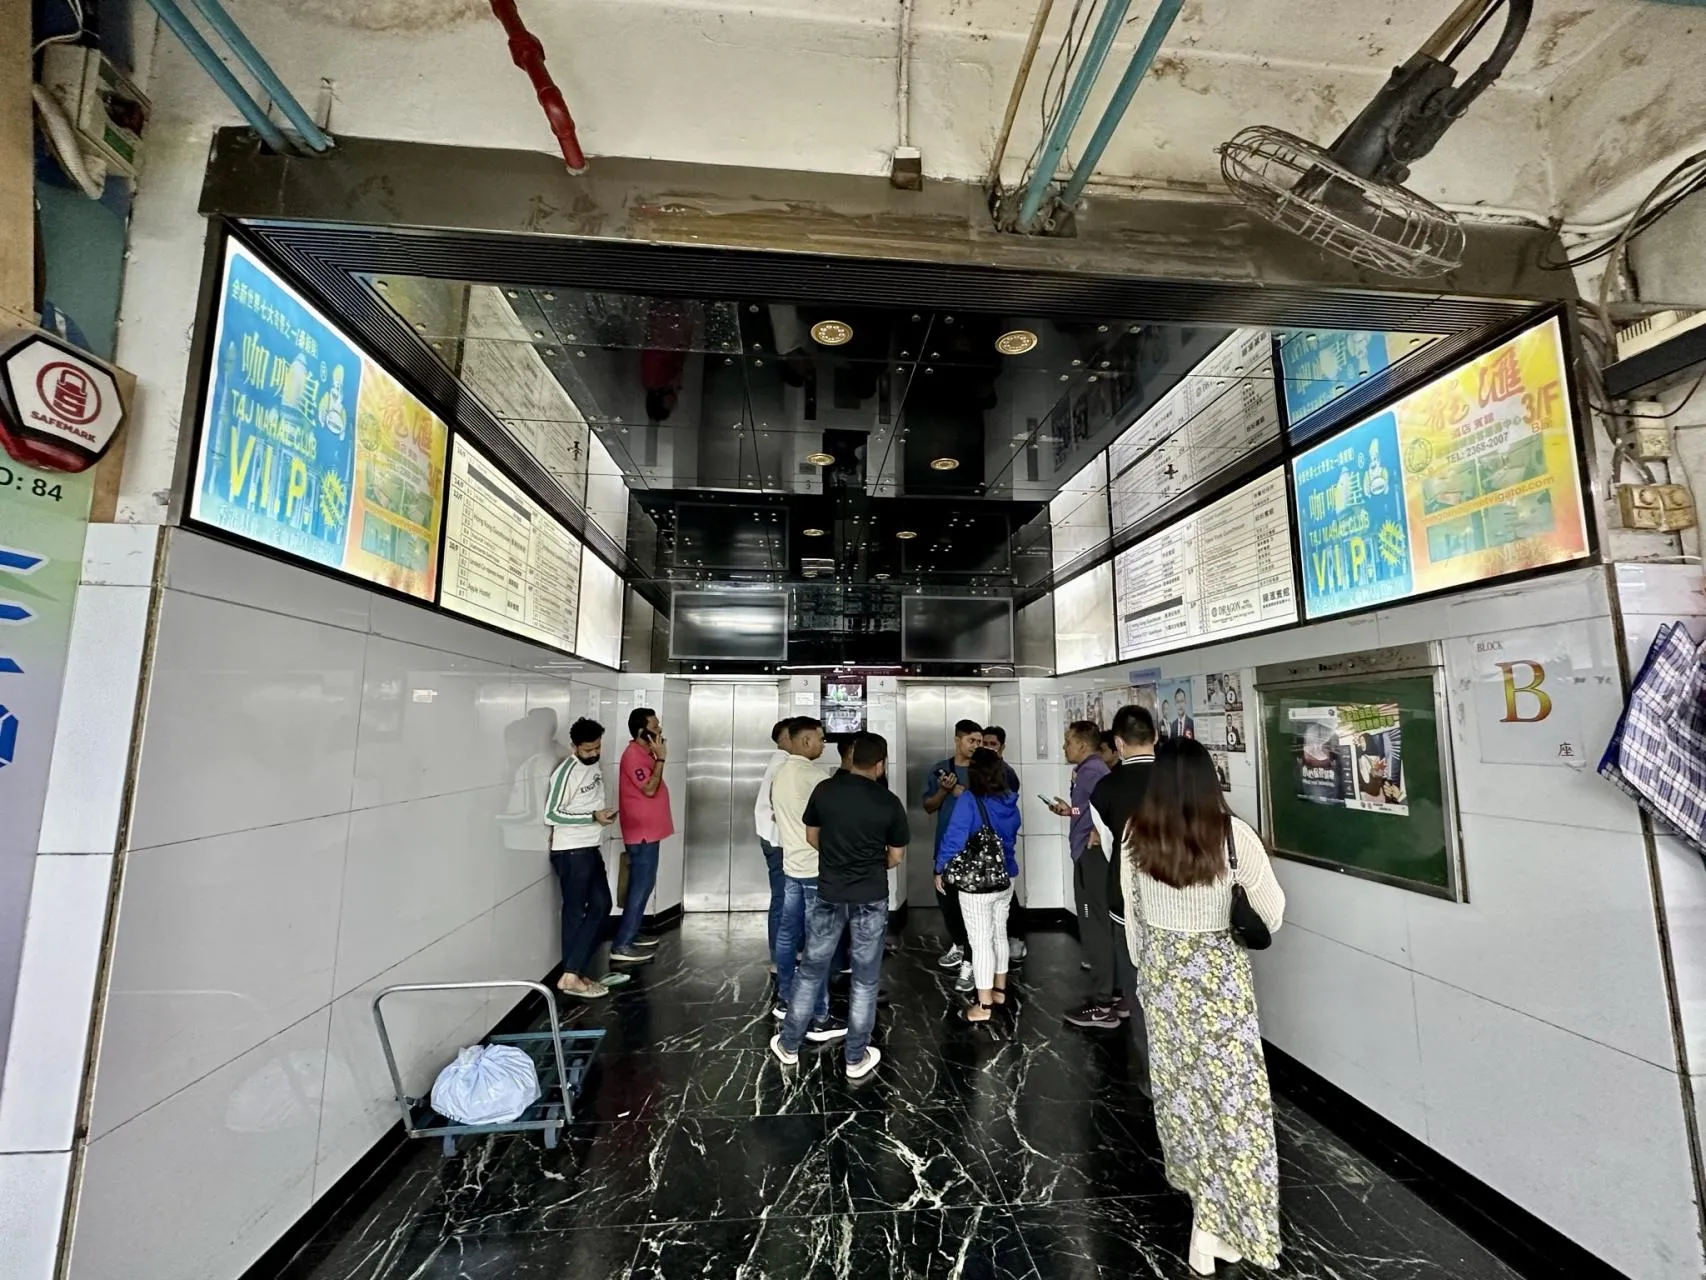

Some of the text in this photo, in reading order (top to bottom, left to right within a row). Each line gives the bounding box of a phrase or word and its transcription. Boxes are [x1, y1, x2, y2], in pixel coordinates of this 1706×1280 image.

[231, 389, 254, 423] TAJ
[1521, 381, 1559, 424] 3/F
[30, 410, 97, 443] SAFEMARK
[32, 478, 63, 502] 84
[1476, 640, 1504, 653] BLOCK
[1495, 659, 1552, 723] B
[1558, 741, 1574, 757] 座
[635, 768, 645, 781] 8
